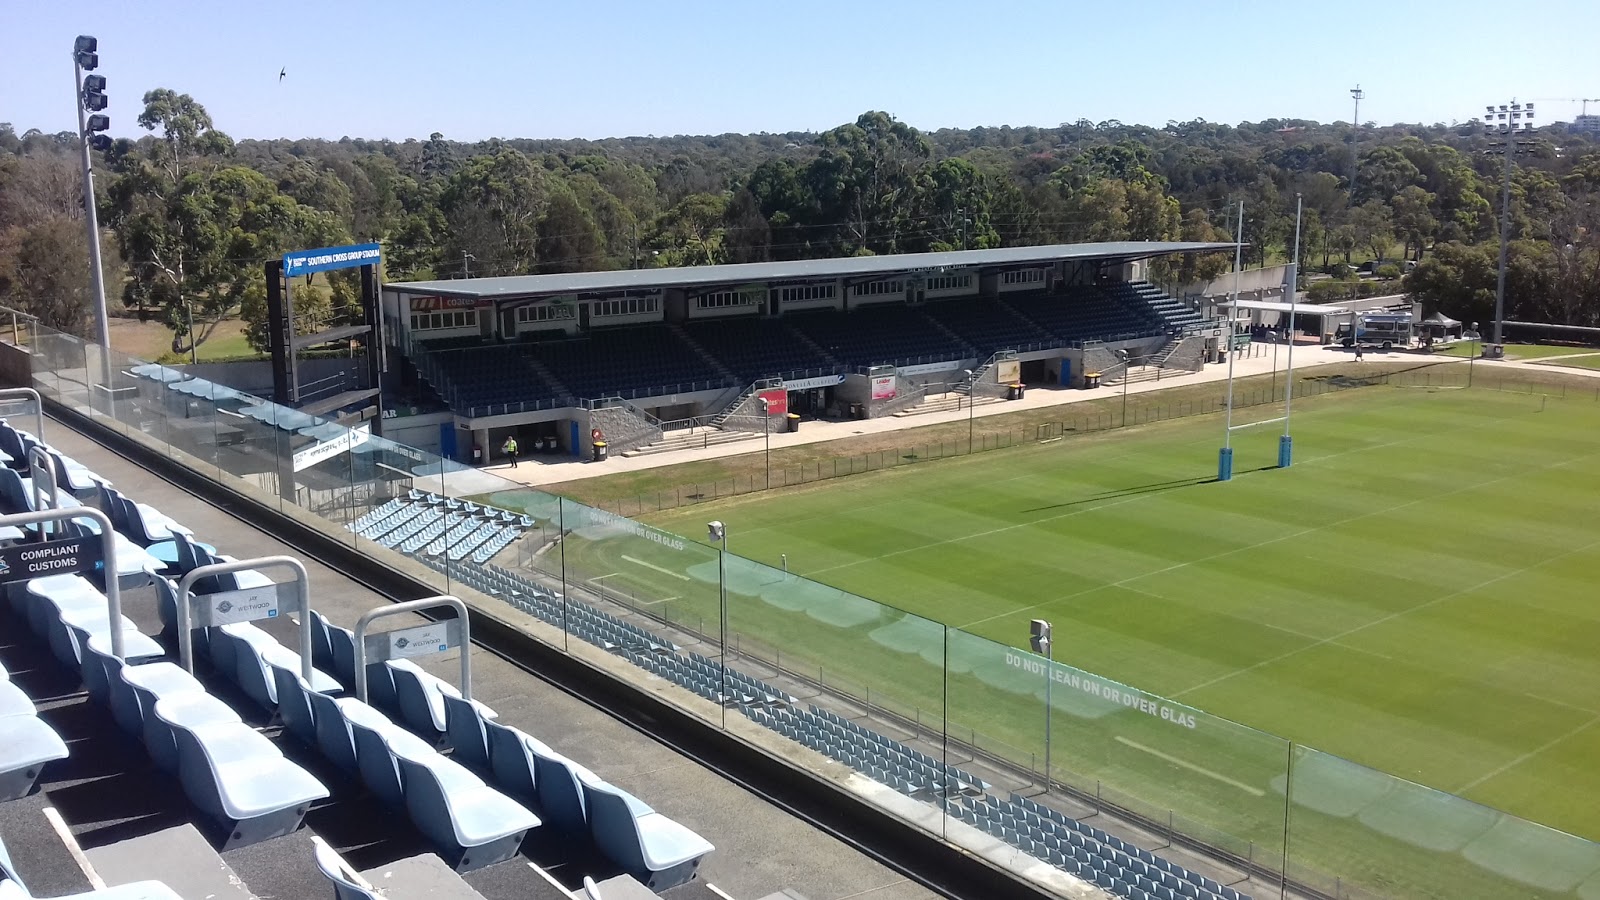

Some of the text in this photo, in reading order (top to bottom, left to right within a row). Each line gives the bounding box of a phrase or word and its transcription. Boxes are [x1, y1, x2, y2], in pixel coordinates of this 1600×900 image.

[307, 249, 380, 266] SOUTHERN CROSS GROUP STADIUM
[636, 528, 646, 538] OR
[645, 531, 662, 544] OVER
[662, 537, 684, 551] GLASS
[20, 544, 80, 561] COMPLIANT
[28, 557, 78, 572] CUSTOMS
[237, 602, 270, 612] WESTWOOD
[1006, 653, 1196, 729] DO NOT LEAN ON OR OVER GLAS
